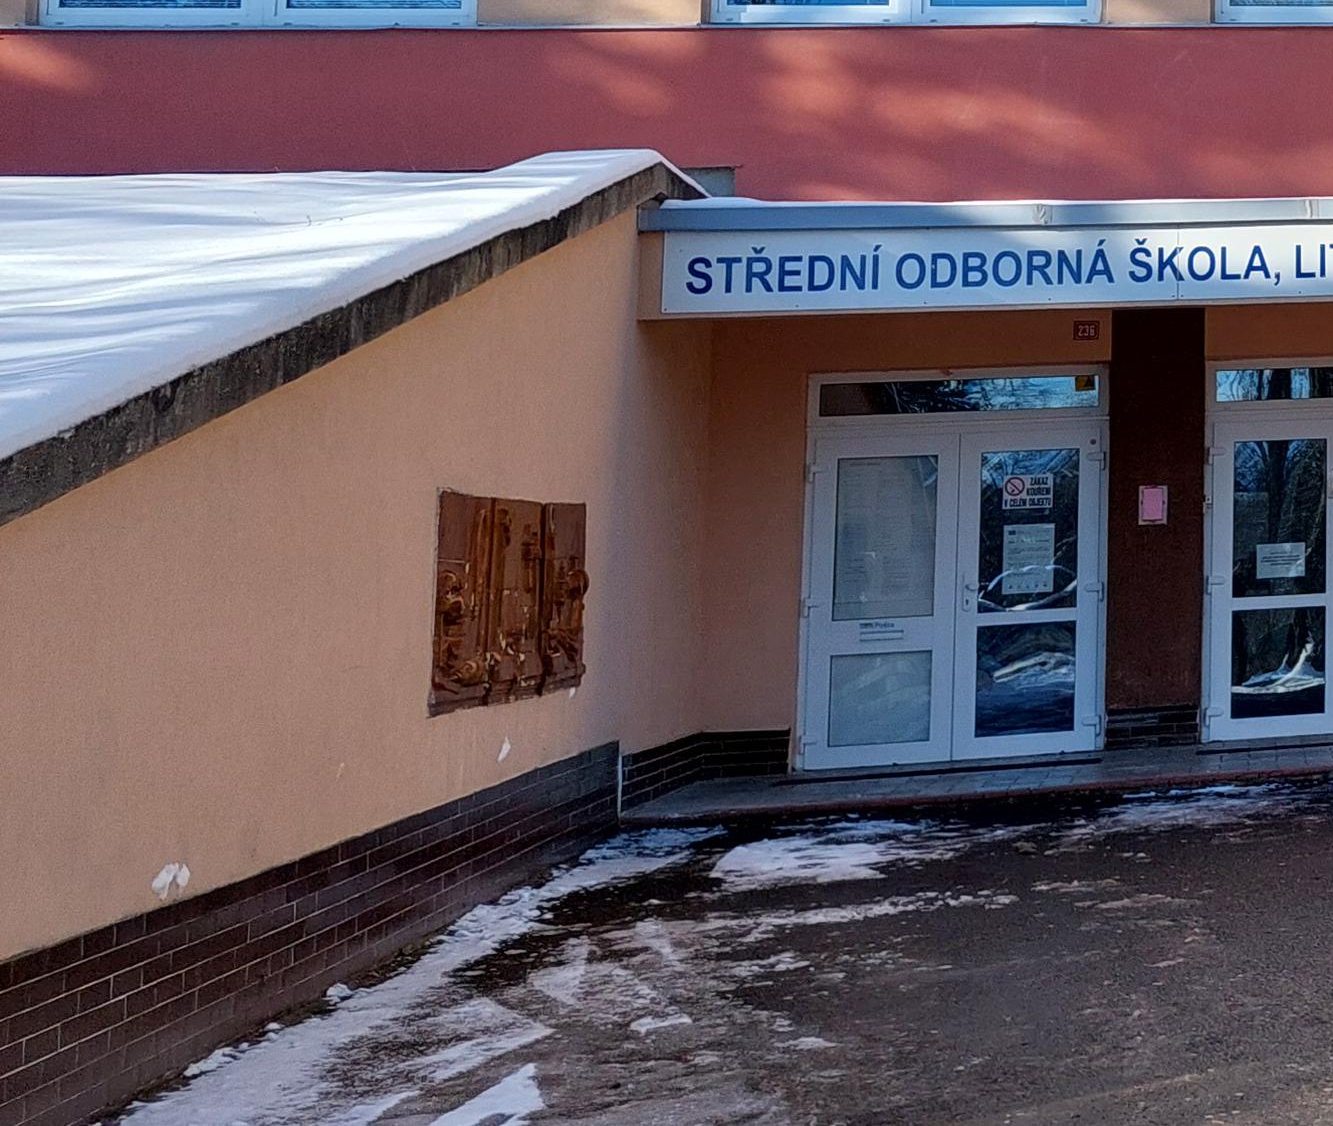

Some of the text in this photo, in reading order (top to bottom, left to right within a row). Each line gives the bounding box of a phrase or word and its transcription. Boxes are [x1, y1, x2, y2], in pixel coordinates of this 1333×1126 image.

[686, 244, 883, 295] STŘEDNÍ
[895, 239, 1116, 290] ODBORNÁ
[1128, 238, 1281, 286] ŠKOLA,
